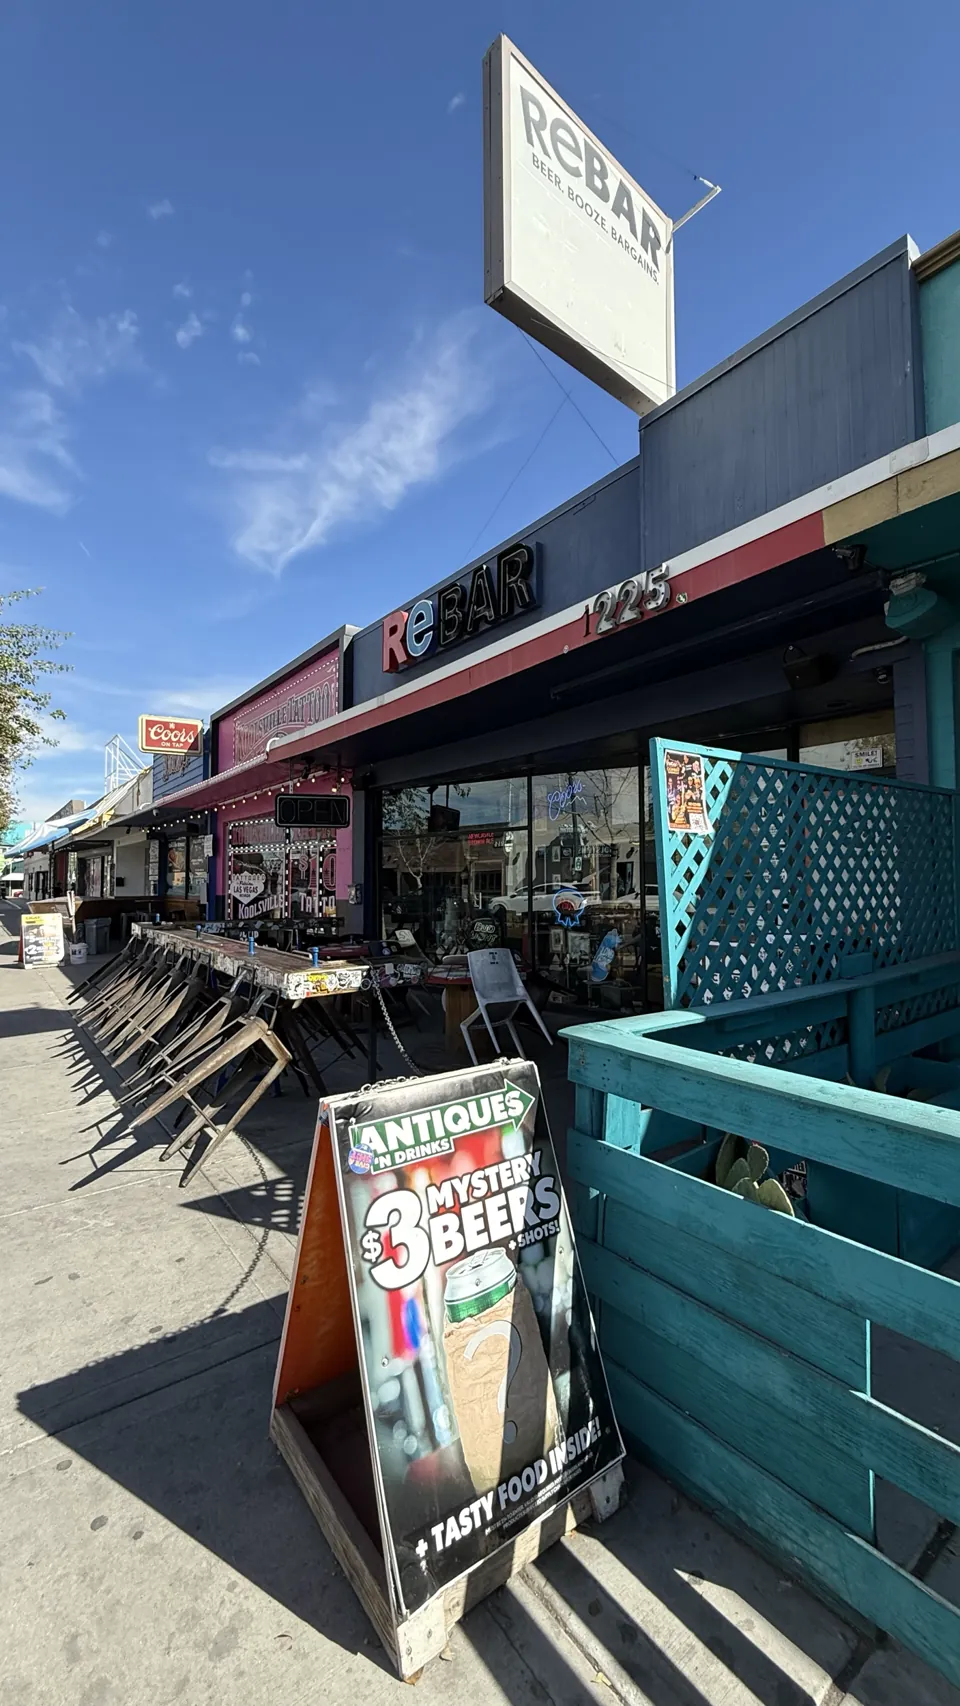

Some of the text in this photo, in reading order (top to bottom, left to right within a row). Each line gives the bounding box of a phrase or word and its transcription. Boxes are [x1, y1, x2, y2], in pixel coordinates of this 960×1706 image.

[519, 85, 662, 273] ReBAR
[531, 152, 660, 286] BEER. BOOZE. BARGAINS.
[382, 543, 535, 673] ReBAR
[583, 562, 671, 638] 1225
[148, 724, 195, 743] Coors
[280, 799, 346, 823] OPEN
[238, 894, 284, 919] KOOLSVILLE
[243, 886, 258, 894] VEGAS
[360, 1090, 524, 1155] ANTIQUES
[395, 1138, 451, 1165] DRINKS
[427, 1151, 541, 1215] MYSTERY
[429, 1177, 560, 1266] BEERS
[518, 1221, 560, 1248] SHOTS!
[430, 1490, 493, 1554] TASTY
[497, 1459, 548, 1511] FOOD
[548, 1416, 602, 1475] INSIDE!
